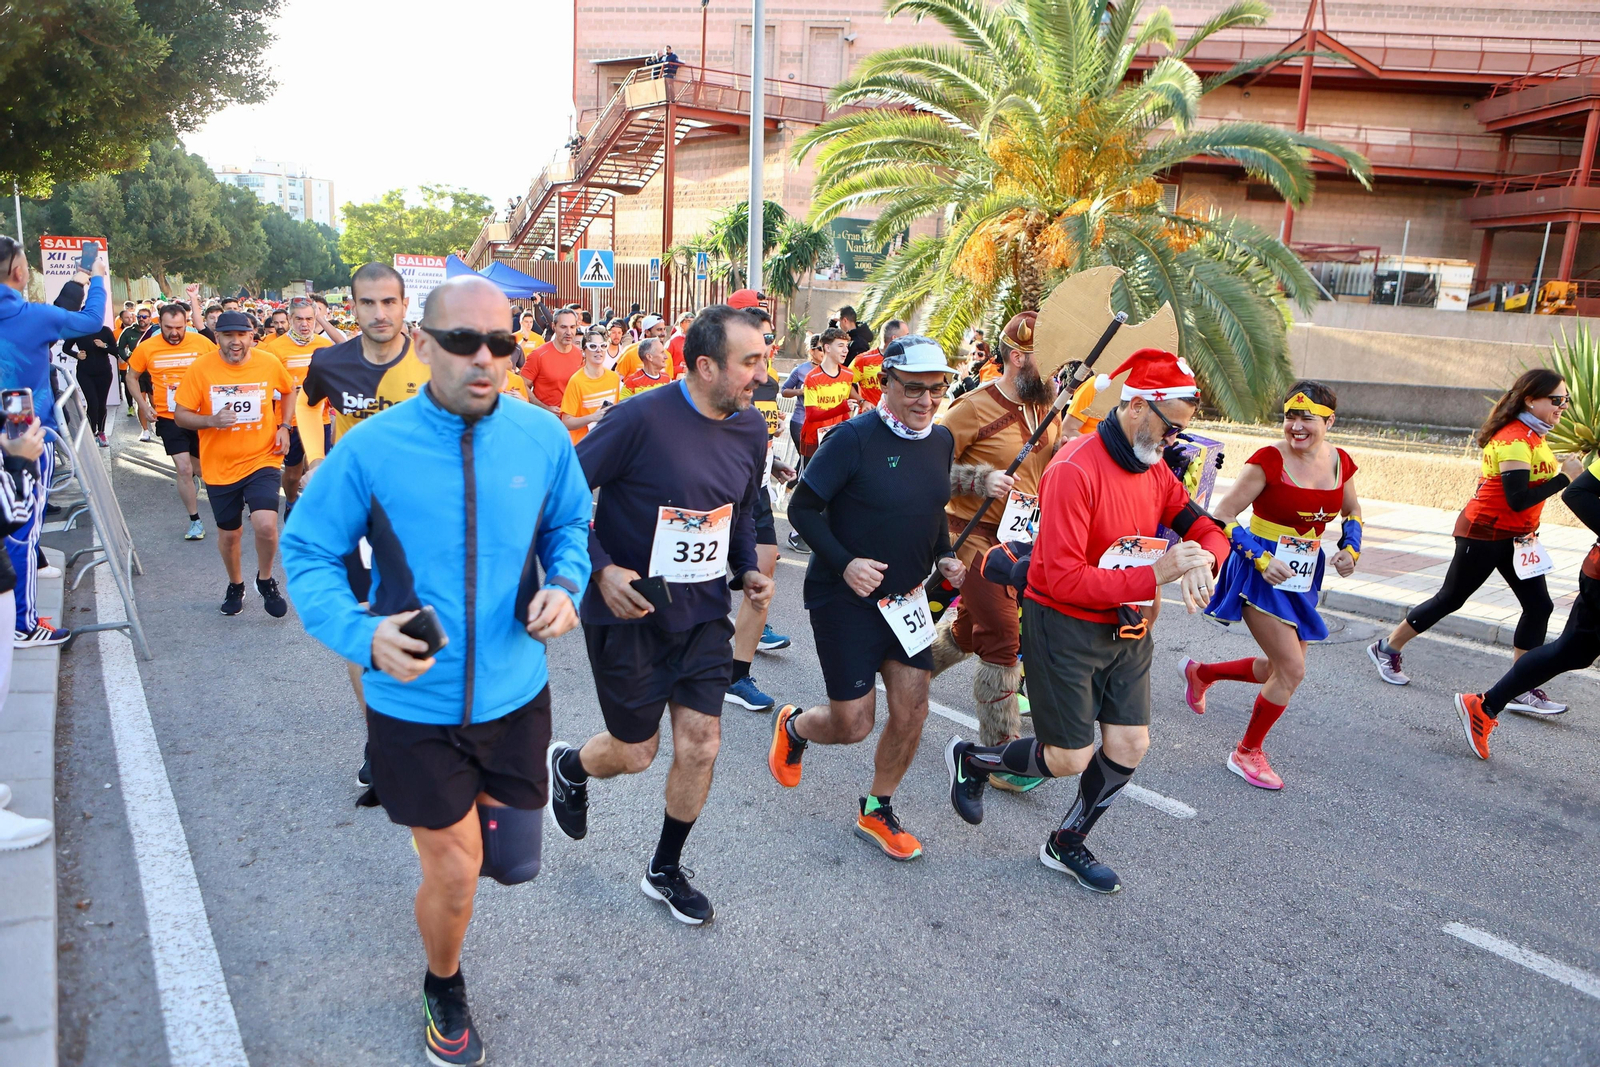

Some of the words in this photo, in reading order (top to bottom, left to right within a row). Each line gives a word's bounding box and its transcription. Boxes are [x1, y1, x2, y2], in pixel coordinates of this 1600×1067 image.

[842, 230, 860, 241] Gran
[44, 238, 104, 249] SALIA
[47, 252, 67, 261] XII
[398, 256, 444, 267] SALIDA
[401, 268, 416, 276] XII
[342, 391, 402, 411] bich
[673, 540, 718, 563] 332
